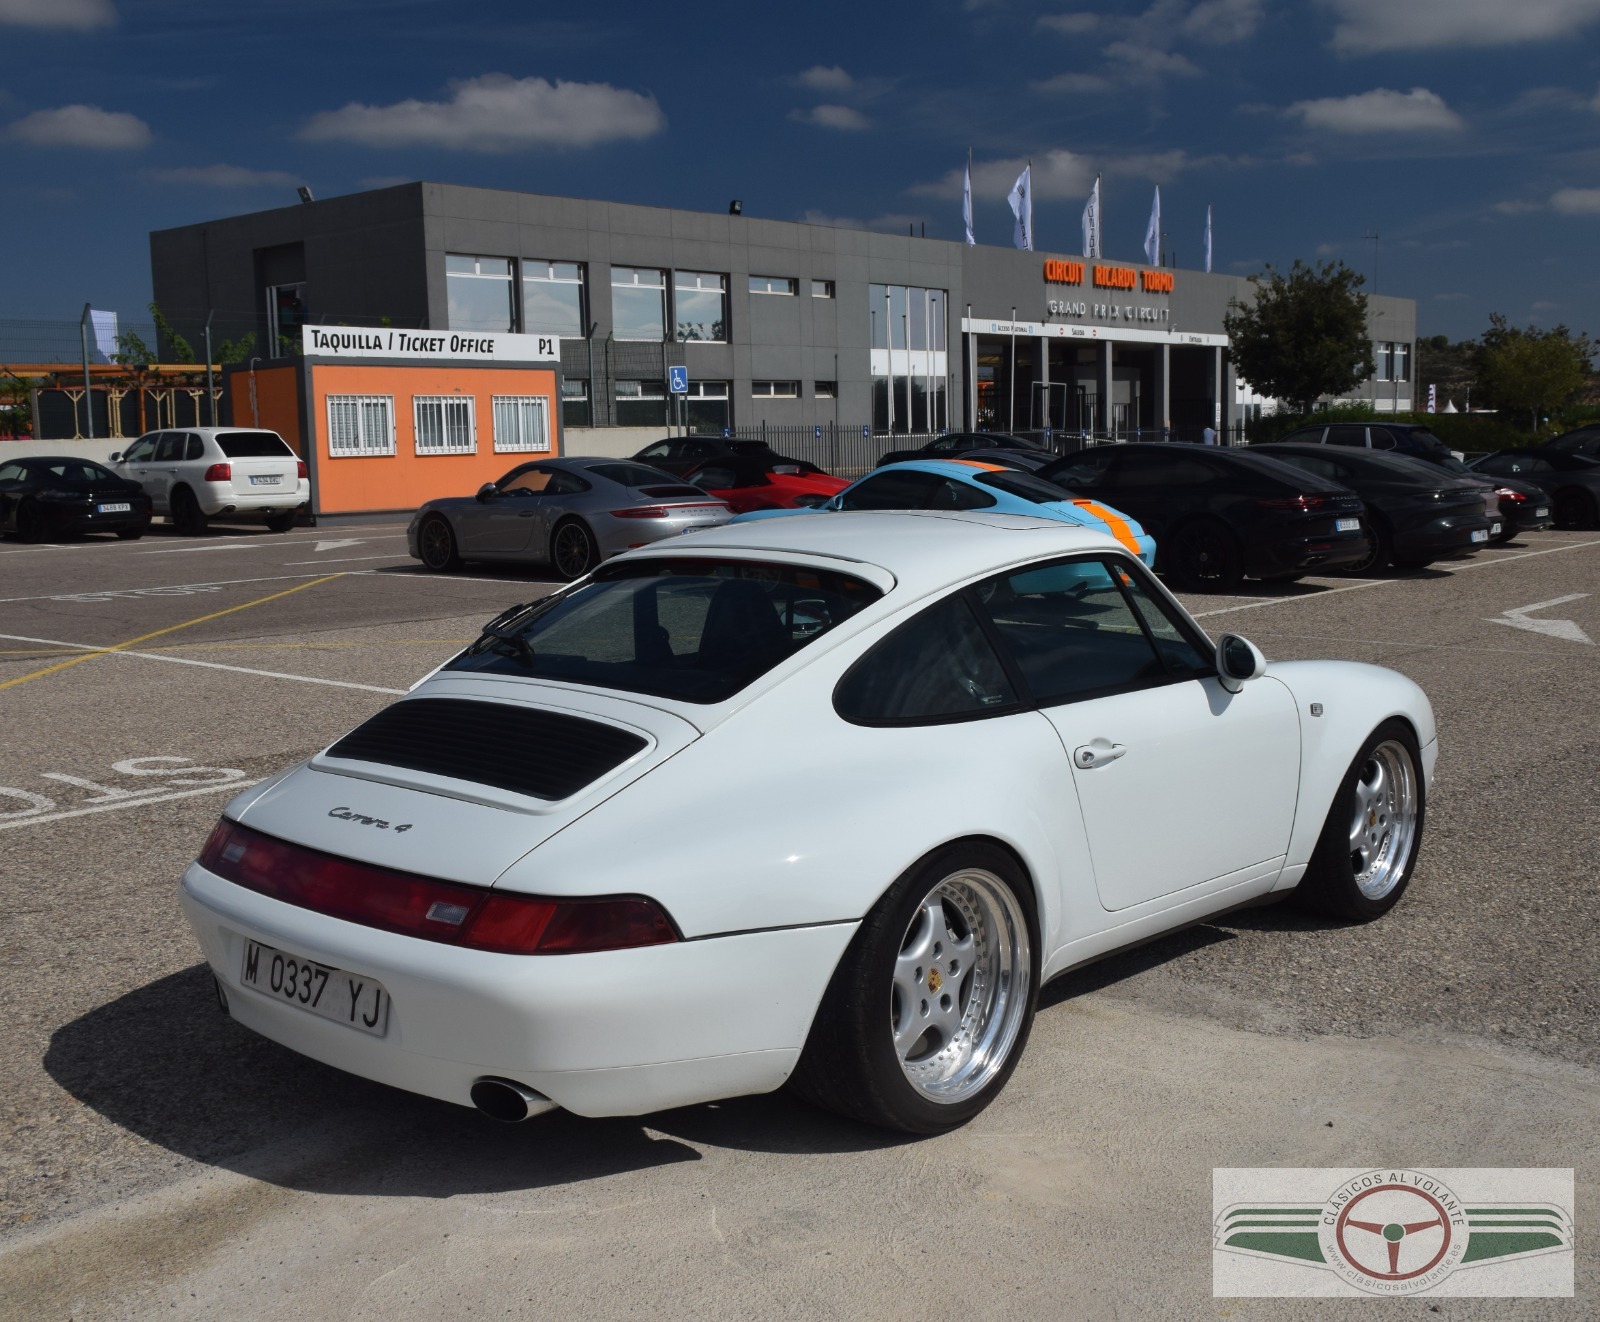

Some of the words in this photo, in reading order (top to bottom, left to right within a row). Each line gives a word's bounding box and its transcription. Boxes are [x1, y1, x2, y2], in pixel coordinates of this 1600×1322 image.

[1045, 259, 1085, 283] CIRCUIT
[1095, 265, 1137, 288] RICARDO
[1141, 270, 1175, 292] TORMO
[1049, 300, 1086, 315] GRAND
[1094, 303, 1120, 318] PRIX
[1124, 305, 1170, 320] CIRCUIT
[1010, 325, 1028, 333] PATONAL
[311, 330, 383, 353] TAQUILLA
[399, 333, 446, 353] TICKET
[450, 335, 495, 354] OFFICE
[538, 338, 555, 355] P1
[327, 806, 390, 829] Carrera
[394, 823, 414, 834] 4
[244, 943, 261, 985] M
[270, 954, 329, 1008] 0337
[348, 979, 382, 1028] YJ
